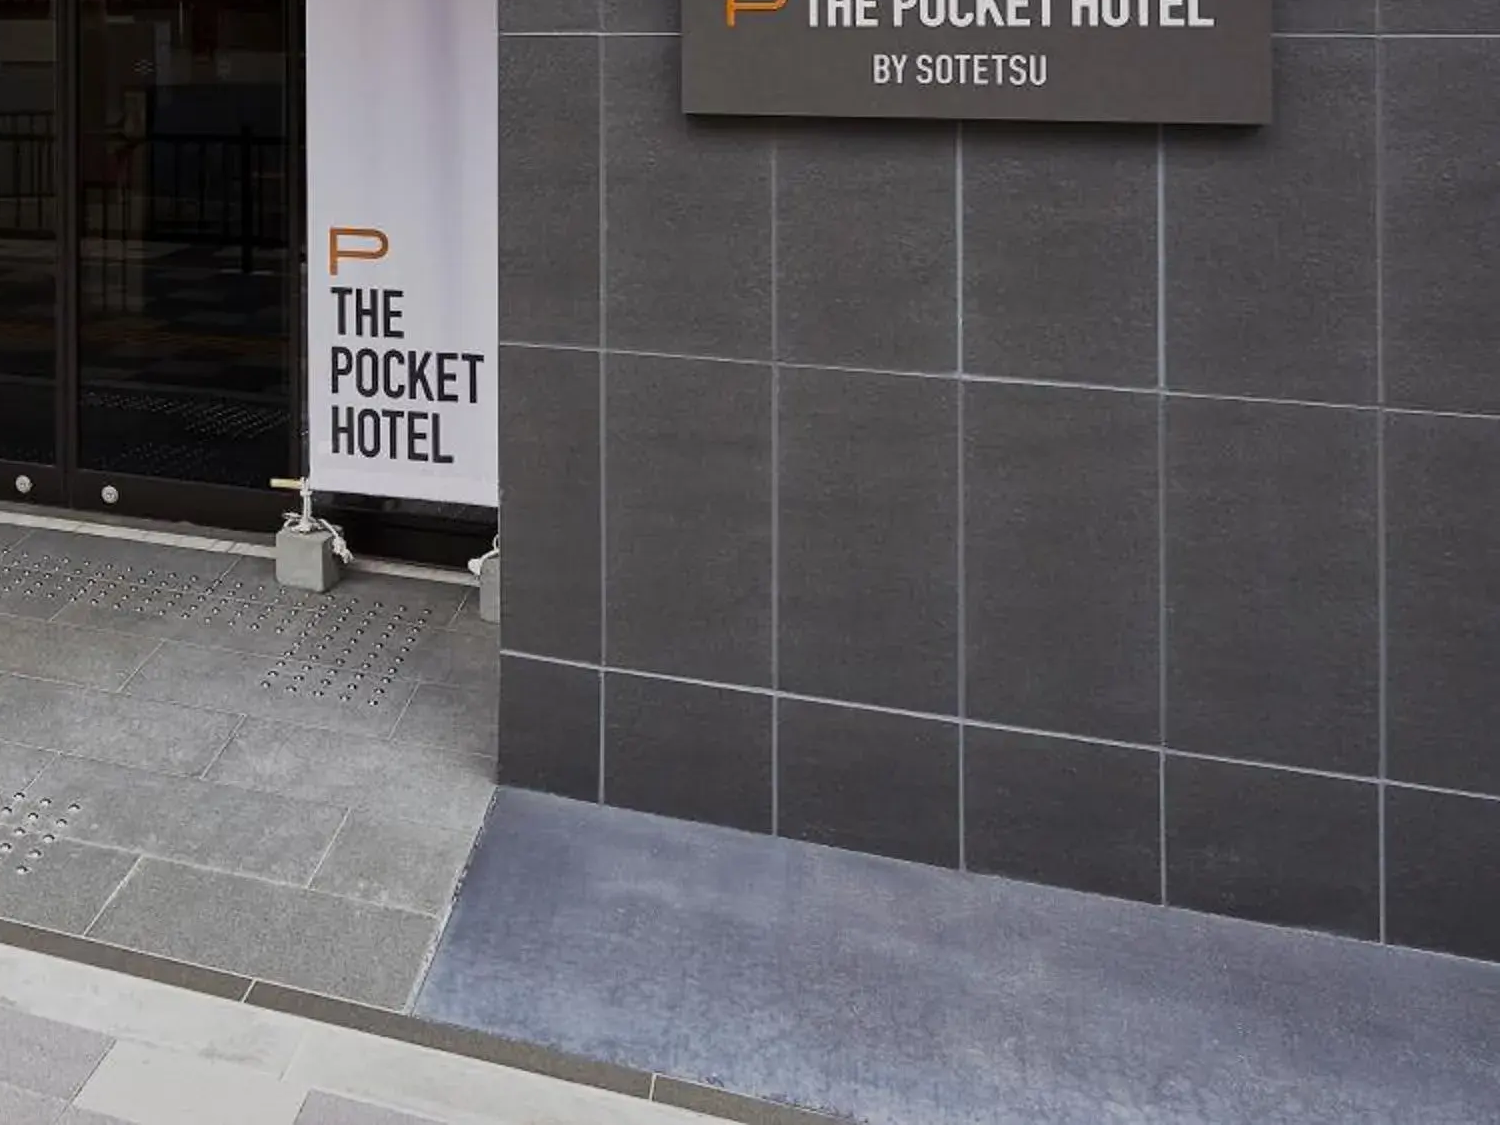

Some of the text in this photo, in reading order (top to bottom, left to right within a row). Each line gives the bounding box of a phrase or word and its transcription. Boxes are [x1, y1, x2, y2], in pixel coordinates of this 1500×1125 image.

[873, 54, 1047, 86] BY SOTETSU
[329, 228, 389, 275] P
[330, 286, 404, 338] THE
[331, 346, 485, 403] POCKET
[331, 405, 454, 463] HOTEL
